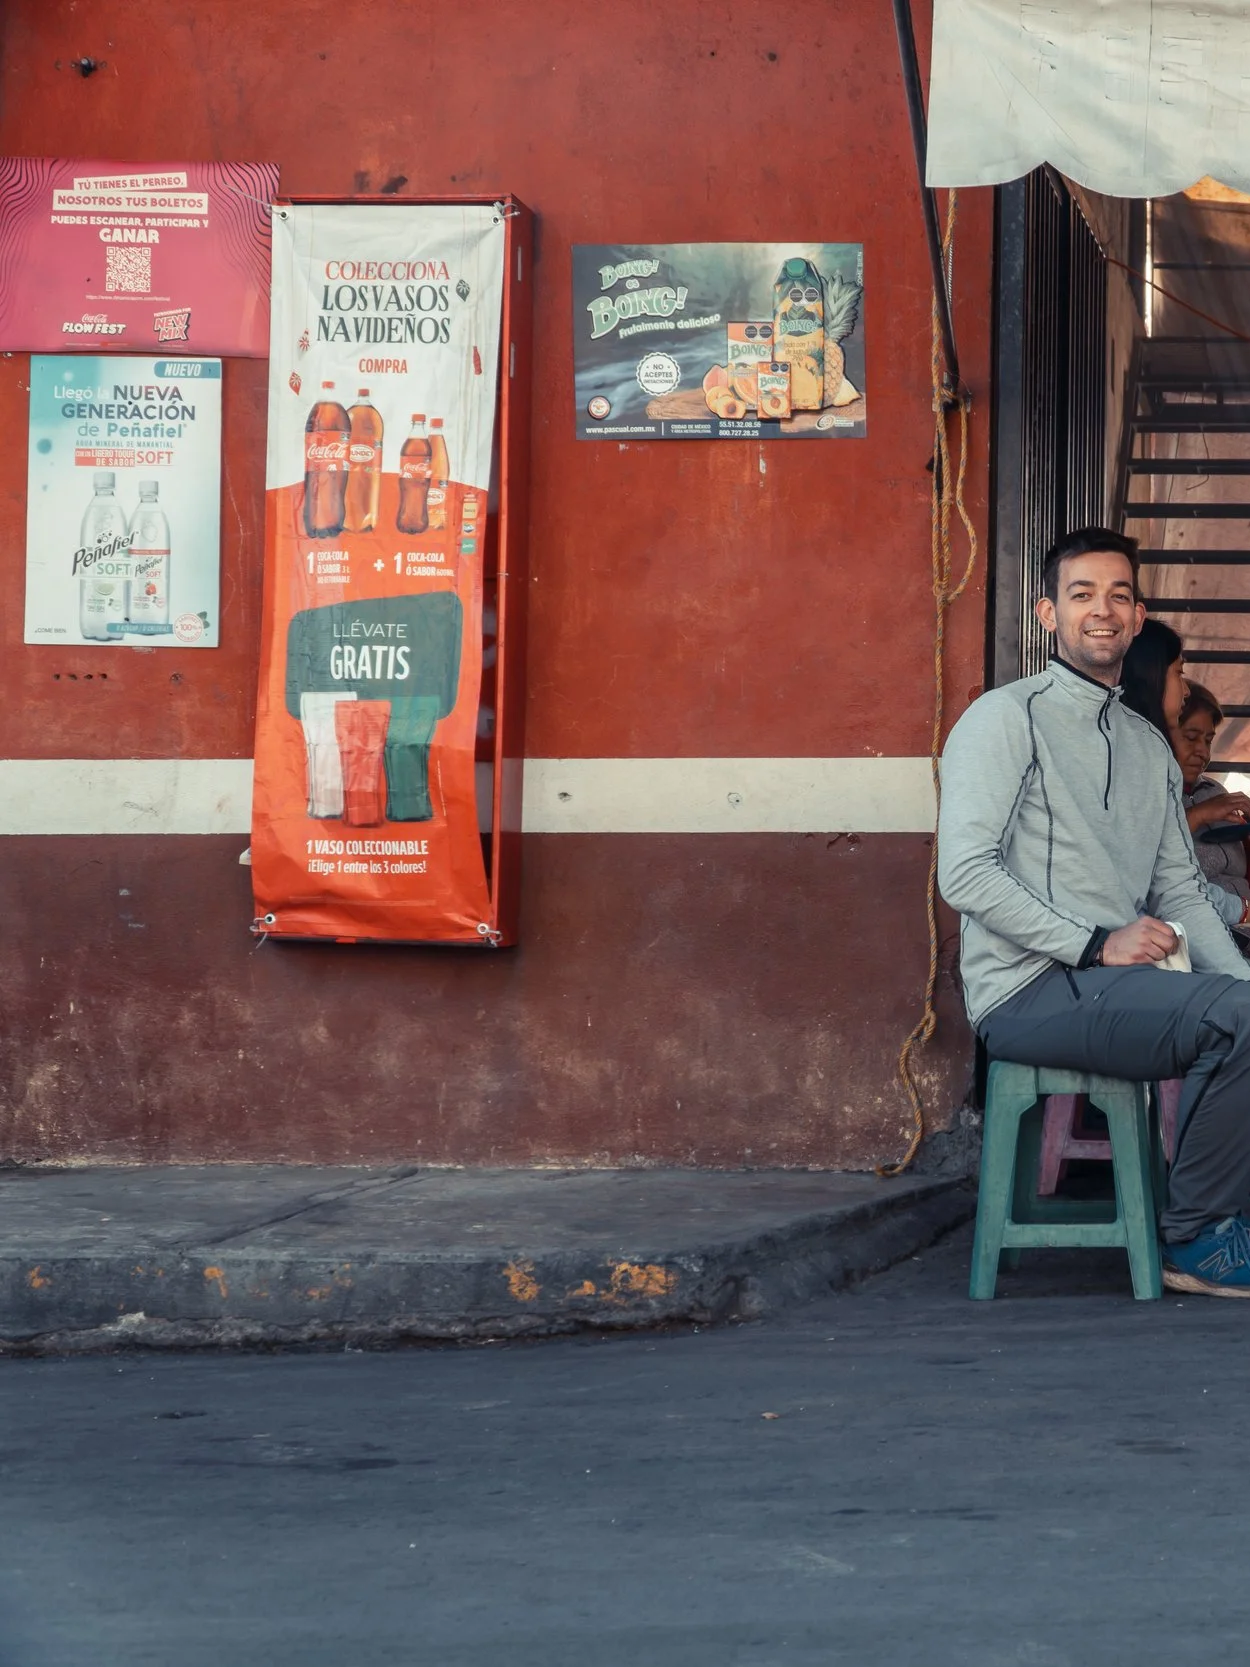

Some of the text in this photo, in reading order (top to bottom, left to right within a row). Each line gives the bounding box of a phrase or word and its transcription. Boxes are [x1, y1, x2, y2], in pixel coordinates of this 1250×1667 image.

[78, 179, 91, 191] TÚ
[94, 179, 127, 190] TIENES
[130, 178, 140, 188] EL
[57, 195, 203, 208] NOSOTROS TUS BOLETOS
[51, 215, 88, 225] PUEDES
[145, 217, 200, 228] PARTICIPAR
[203, 219, 209, 228] Y
[99, 228, 160, 244] GANAR
[325, 260, 450, 281] COLECCIONA
[321, 284, 449, 312] LOS VASOS
[587, 286, 689, 340] BOING!
[677, 313, 721, 329] delicioso
[62, 322, 127, 335] FLOW FEST
[154, 313, 190, 331] NEW
[316, 313, 451, 344] NAVIDEÑOS
[158, 325, 188, 342] MIX
[164, 363, 202, 377] NUEVO
[358, 358, 408, 374] COMPRA
[54, 385, 93, 401] Llegó
[113, 385, 183, 401] NUEVA
[61, 400, 196, 421] GENERACIÓN
[78, 422, 183, 438] de Peñafiel
[586, 425, 656, 434] www.pascual.com.mx
[126, 440, 134, 448] DE
[307, 442, 349, 459] Coca-Cola
[91, 449, 114, 457] LIGERO
[115, 449, 135, 459] TOQUE
[96, 458, 135, 466] DE SABOR
[136, 451, 174, 464] SOFT
[307, 551, 315, 574] 1
[317, 551, 349, 561] COCA-COLA
[394, 551, 402, 574] 1
[407, 552, 445, 562] COCA-COLA
[96, 562, 131, 575] SOFT
[406, 564, 412, 576] Ó
[413, 566, 436, 576] SABOR
[333, 619, 408, 638] LLÉVATE
[330, 645, 411, 680] GRATIS
[306, 840, 429, 855] 1 VASO COLECCIONABLE
[308, 859, 427, 875] ¡Elige 1 entre los 3 colores!
